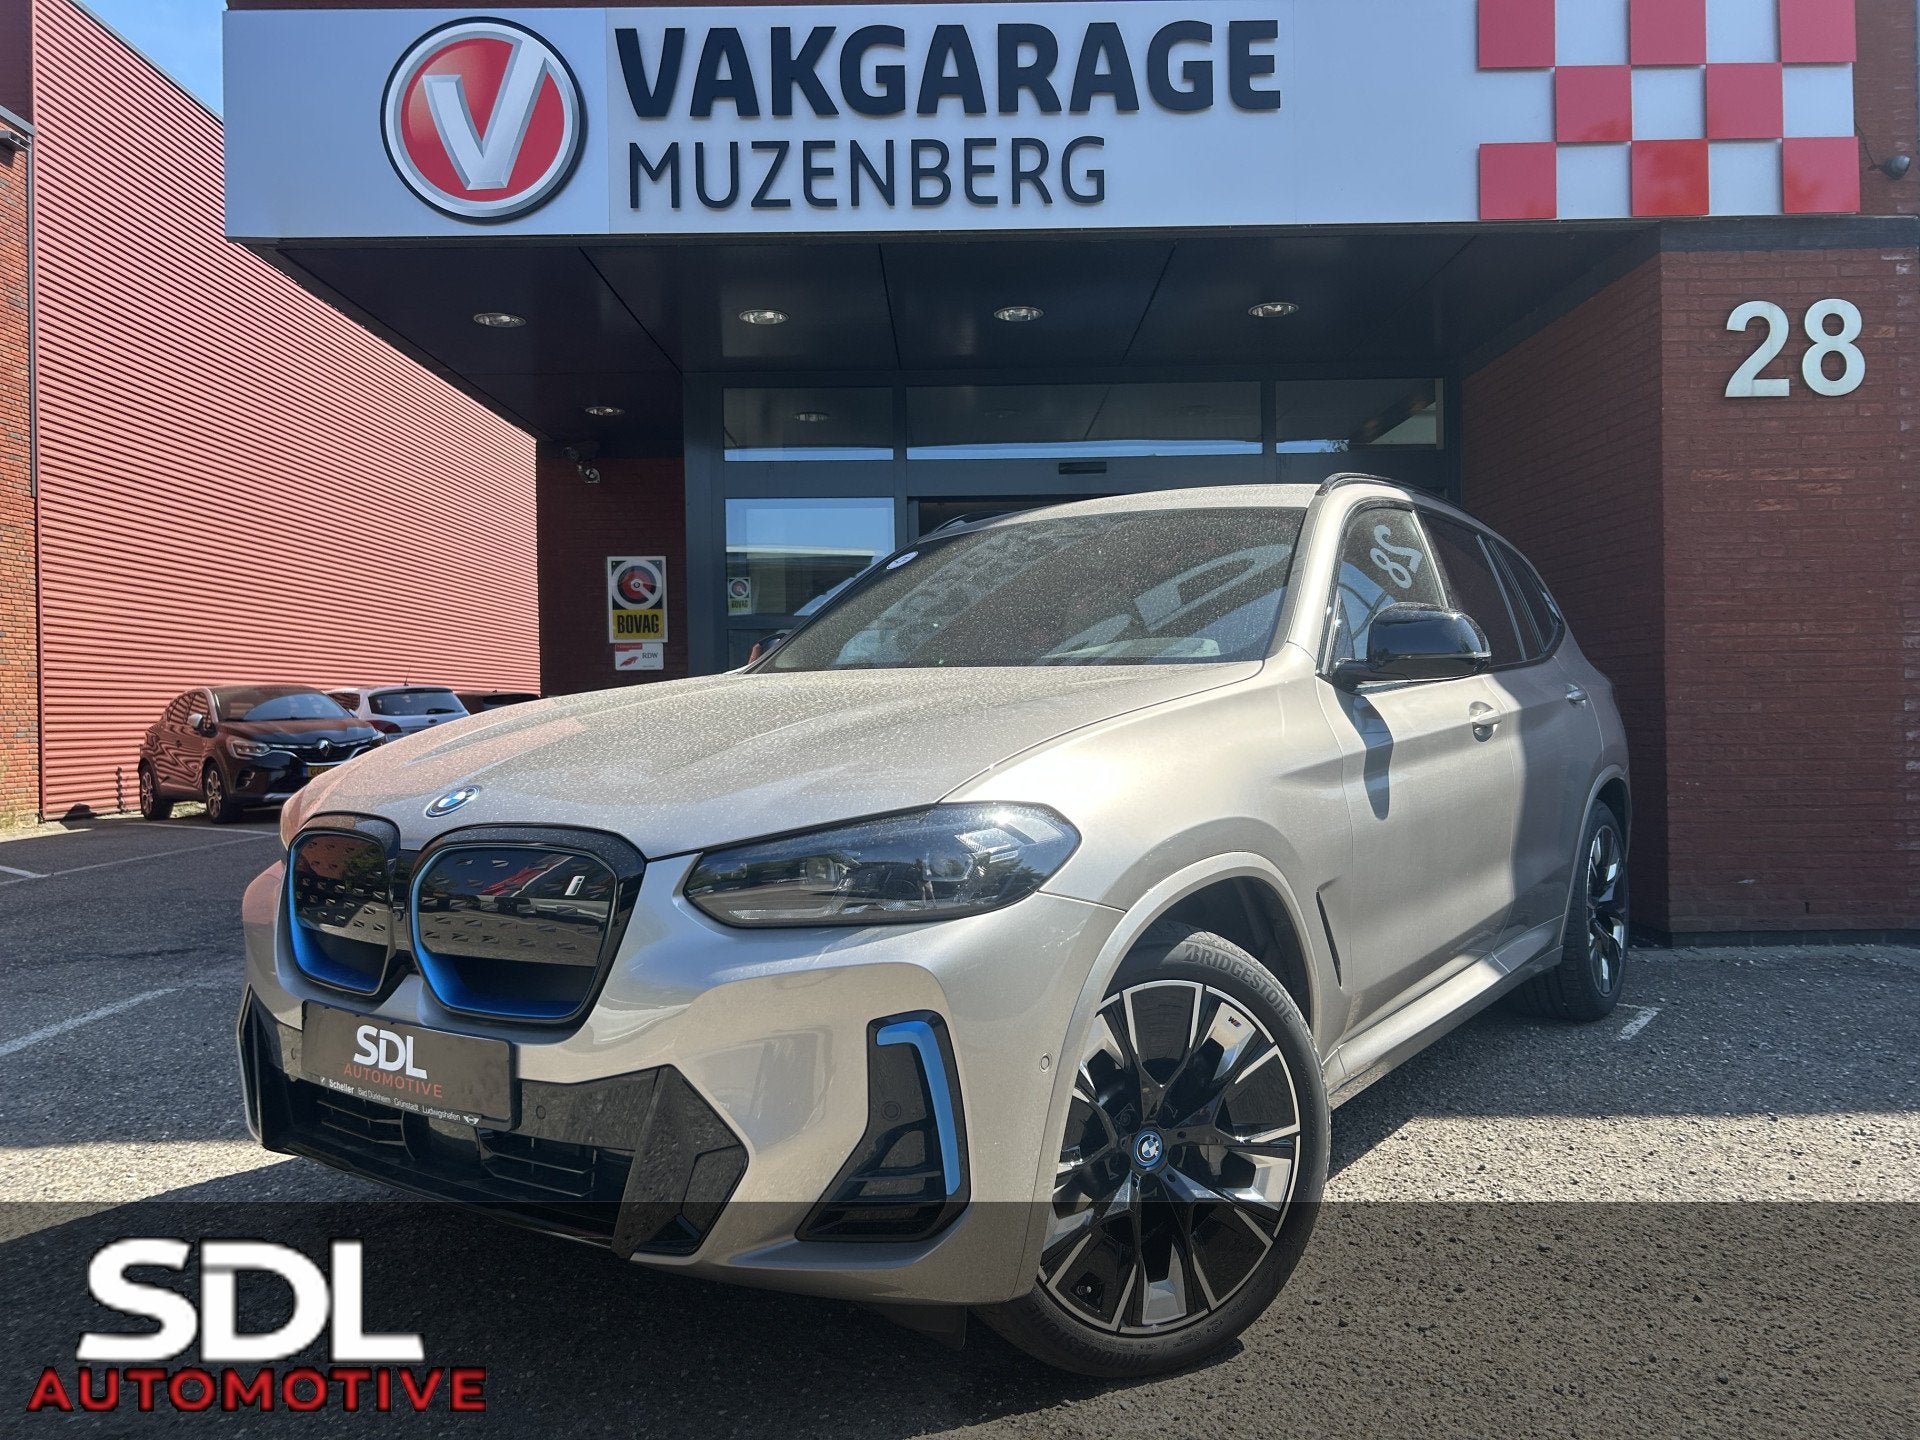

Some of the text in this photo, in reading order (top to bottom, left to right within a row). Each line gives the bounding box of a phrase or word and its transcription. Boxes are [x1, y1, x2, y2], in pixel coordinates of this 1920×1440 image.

[615, 20, 1281, 118] VAKGARAGE
[628, 136, 1106, 209] MUZENBERG
[1725, 298, 1866, 397] 28
[617, 614, 659, 634] BOVAG
[1182, 944, 1295, 1024] BRIDGESTONE
[343, 1063, 443, 1098] AUTOMOTIVE
[353, 1024, 428, 1079] SDL
[329, 1079, 354, 1094] Scheller
[422, 1105, 460, 1120] Ludwigshafen
